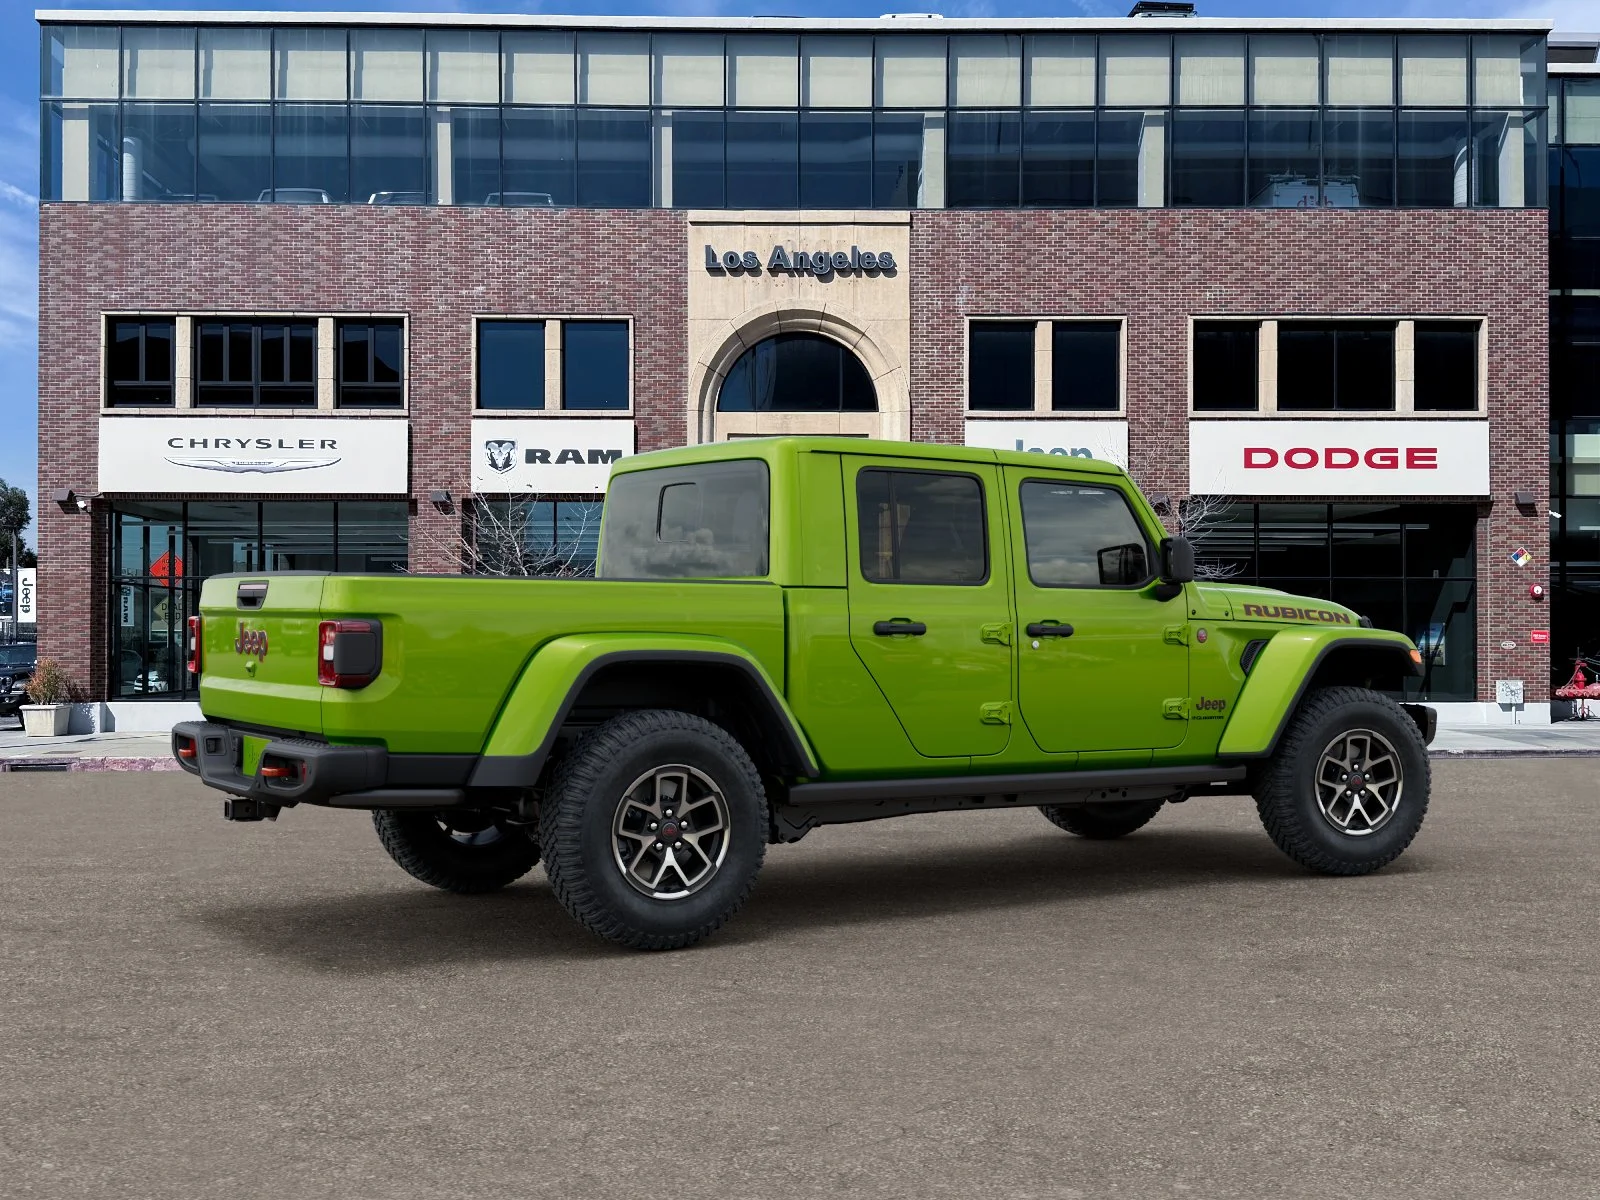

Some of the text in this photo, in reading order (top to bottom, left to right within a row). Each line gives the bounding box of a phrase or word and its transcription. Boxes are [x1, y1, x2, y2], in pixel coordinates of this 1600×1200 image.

[1297, 195, 1334, 207] dih
[705, 245, 895, 275] Los Angeles
[167, 437, 338, 450] CHRYSLER
[525, 448, 623, 465] RAM
[1243, 447, 1438, 470] DODGE
[20, 577, 34, 613] Jeep
[164, 612, 182, 620] ED
[1243, 603, 1351, 625] RUBICON
[234, 621, 268, 662] Jeep
[1195, 696, 1226, 713] Jeep
